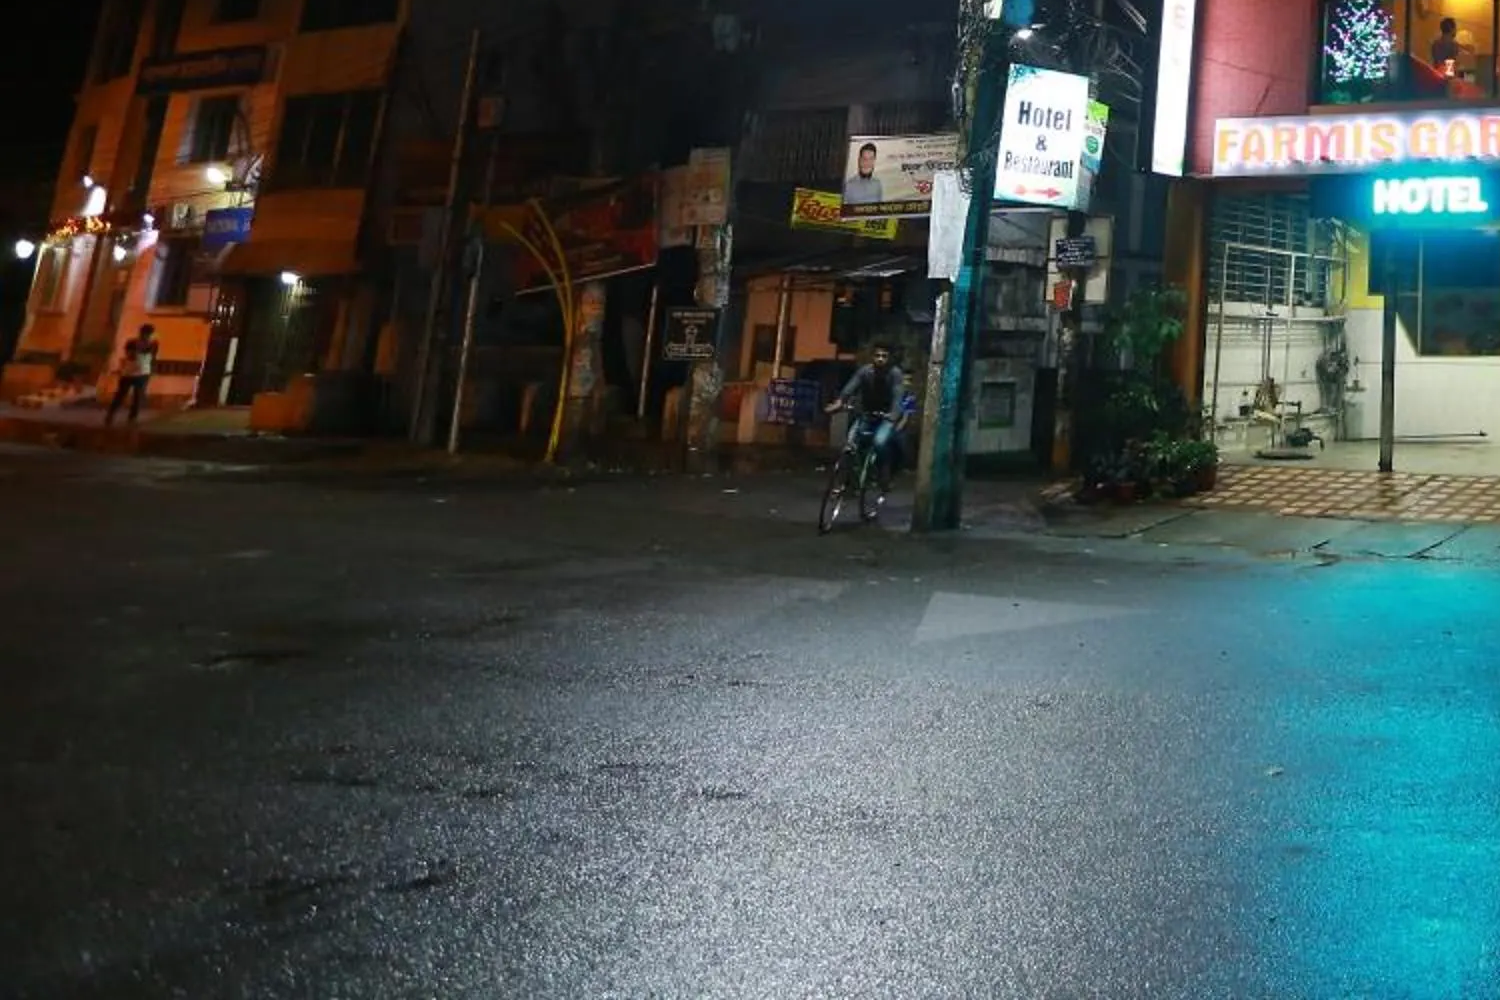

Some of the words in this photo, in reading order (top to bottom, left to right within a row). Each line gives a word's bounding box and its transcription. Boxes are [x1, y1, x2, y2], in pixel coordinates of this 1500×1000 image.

[1017, 100, 1072, 132] Hotel
[1035, 134, 1047, 152] &
[1216, 121, 1398, 164] FARMIS
[1004, 151, 1074, 179] Restaurant
[1374, 176, 1489, 214] HOTEL
